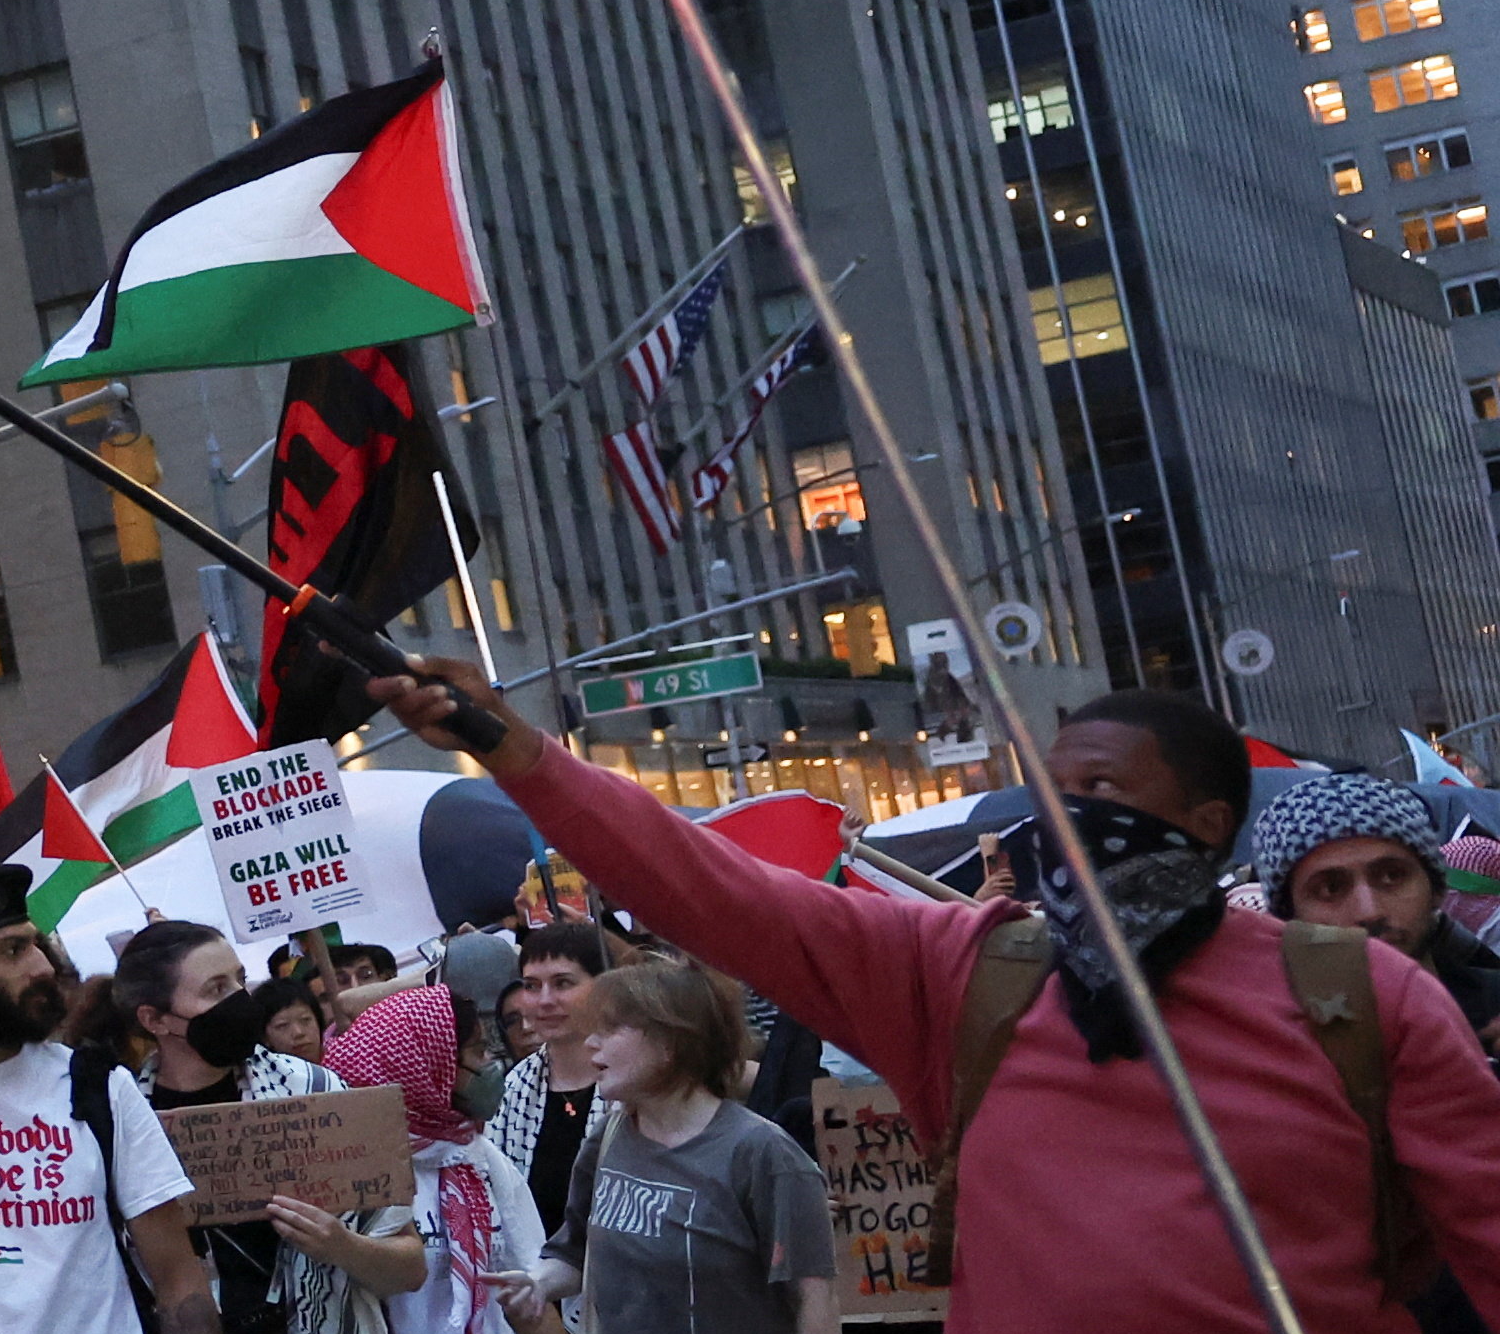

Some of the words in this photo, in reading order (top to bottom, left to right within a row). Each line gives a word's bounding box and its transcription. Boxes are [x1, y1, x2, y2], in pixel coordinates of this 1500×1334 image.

[628, 679, 644, 701] W
[654, 673, 680, 695] 49
[687, 669, 710, 691] St
[217, 767, 262, 796] END
[267, 753, 310, 780] THE
[213, 771, 328, 820] BLOCKADE
[212, 815, 263, 841] BREAK
[266, 806, 296, 826] THE
[299, 793, 342, 816] SIEGE
[230, 851, 291, 883] GAZA
[295, 834, 351, 865] WILL
[247, 879, 282, 906] BE
[288, 860, 348, 896] FREE
[180, 1145, 218, 1160] ears
[854, 1119, 916, 1151] ISR
[33, 1157, 65, 1191] is
[828, 1162, 887, 1194] HAS
[840, 1203, 880, 1236] TO
[885, 1202, 932, 1235] GO
[864, 1241, 928, 1295] HE
